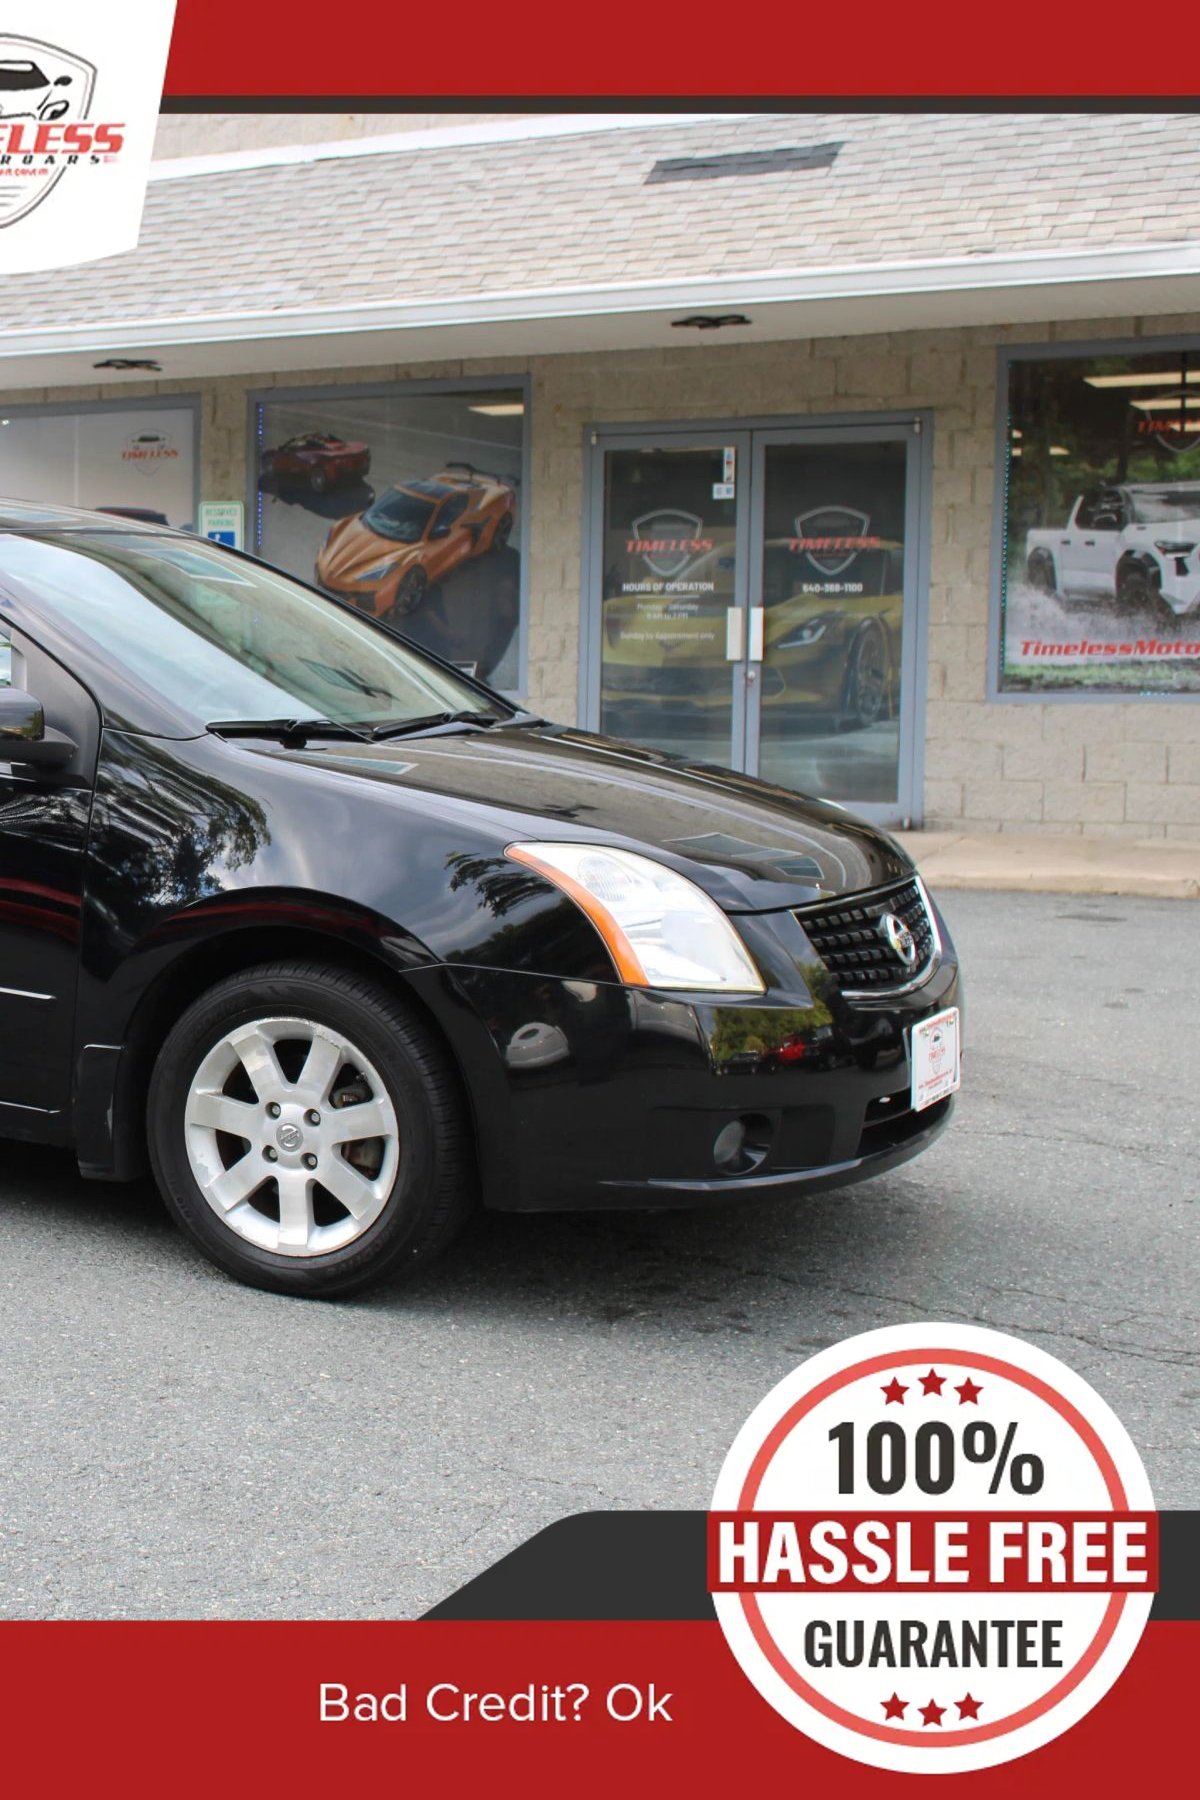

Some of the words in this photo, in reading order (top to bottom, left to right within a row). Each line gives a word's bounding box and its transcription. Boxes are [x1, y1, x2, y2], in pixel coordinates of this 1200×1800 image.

[624, 539, 715, 553] TIMELESS
[622, 582, 651, 592] HOURS
[652, 582, 664, 592] OF
[665, 582, 714, 592] OPERATION
